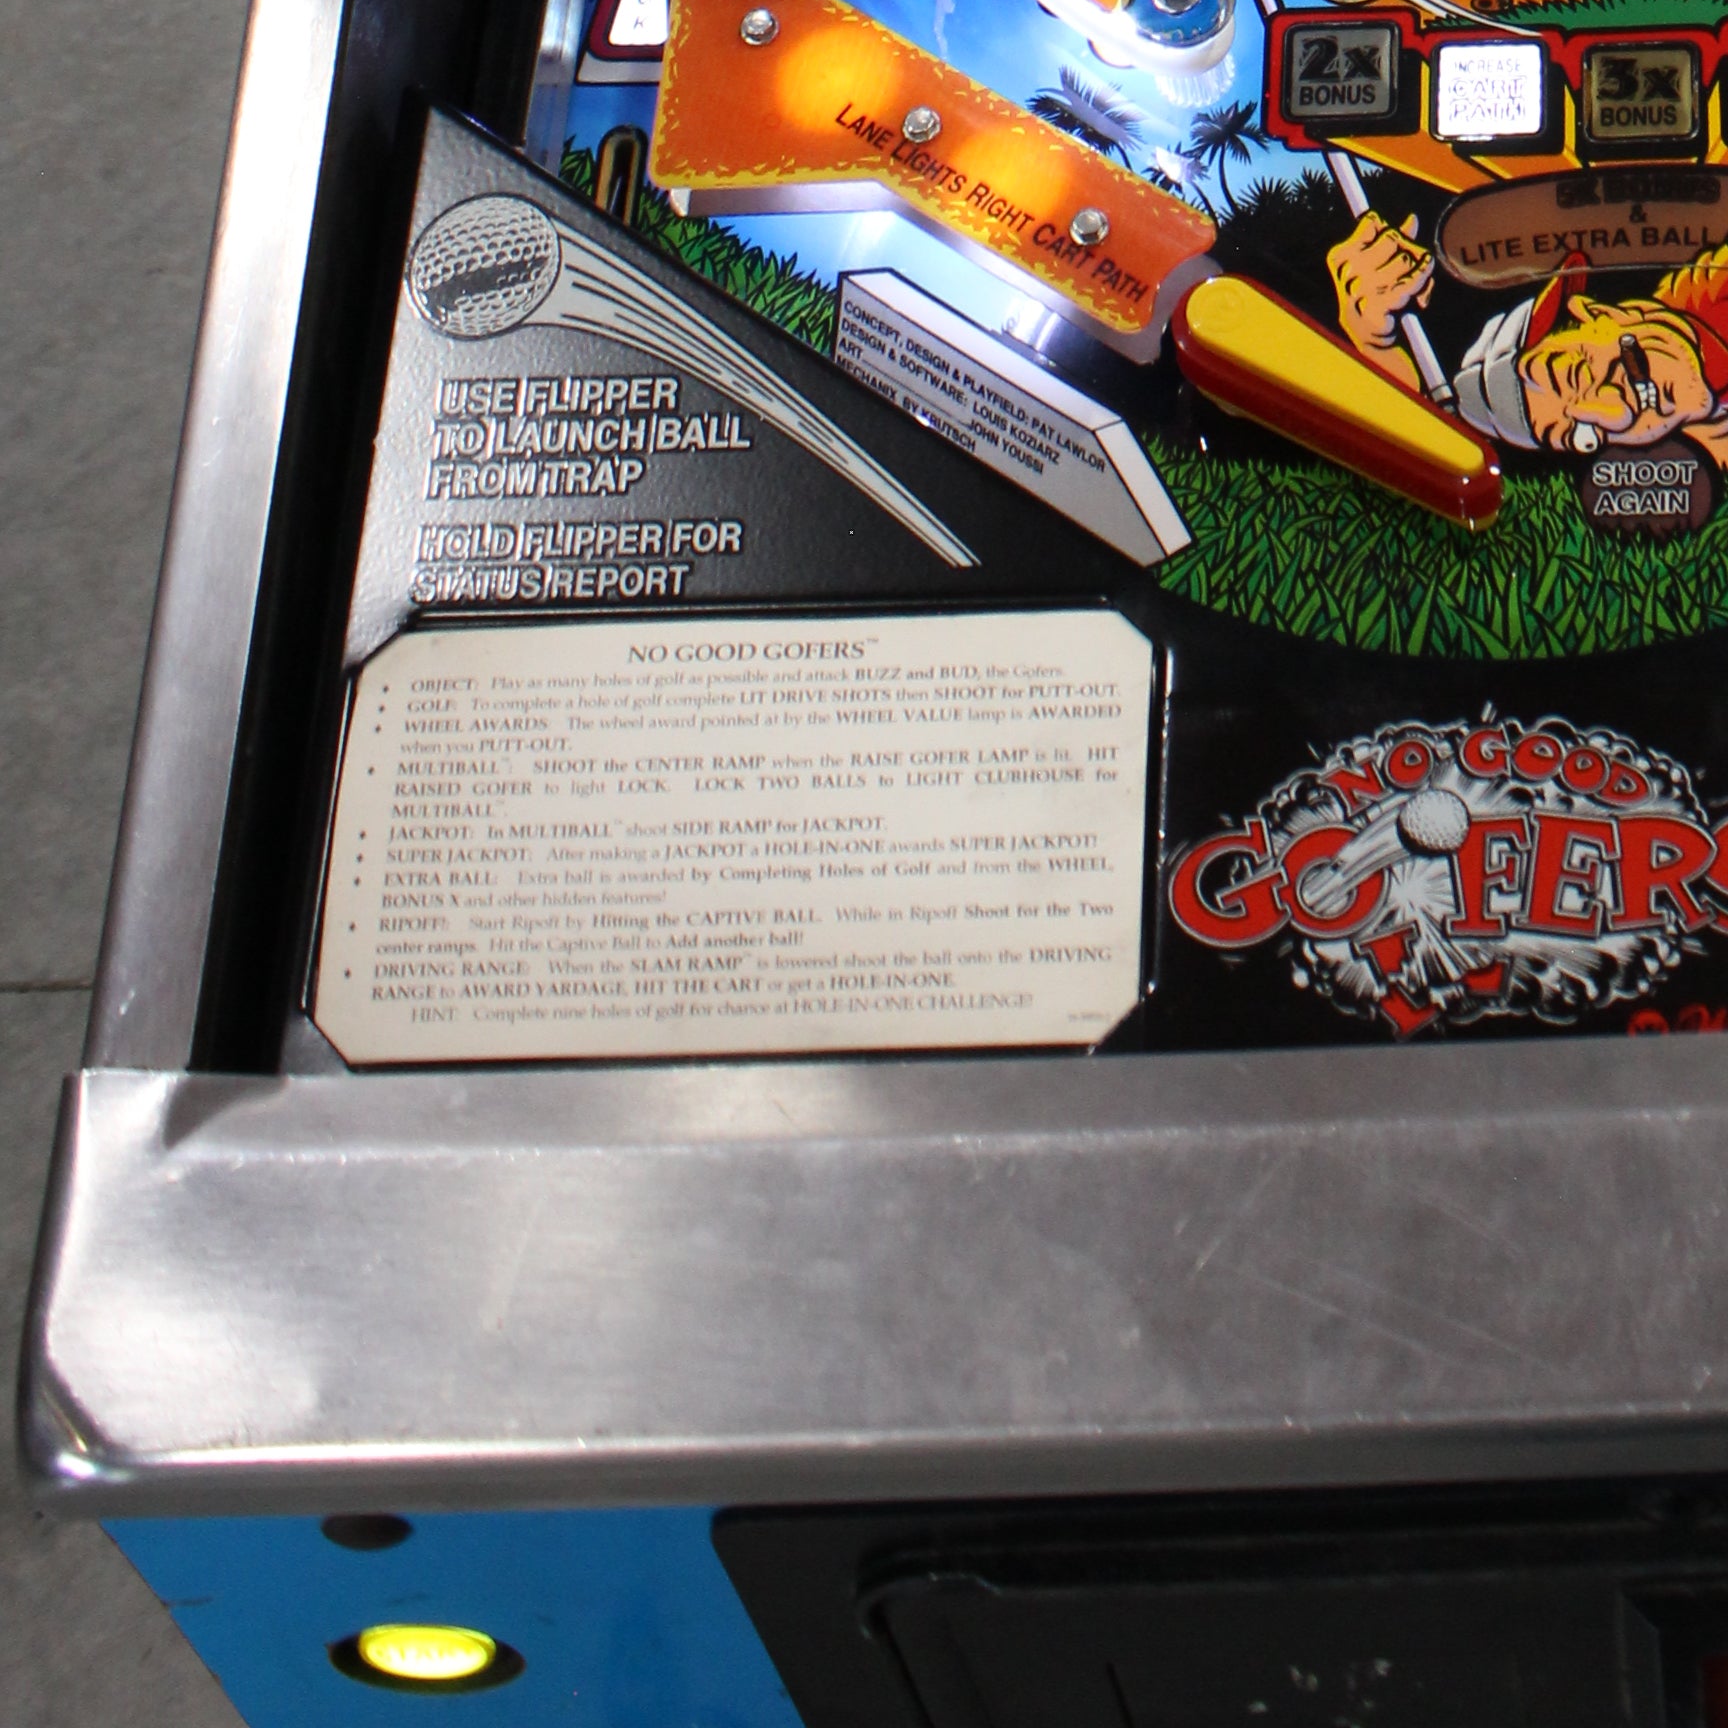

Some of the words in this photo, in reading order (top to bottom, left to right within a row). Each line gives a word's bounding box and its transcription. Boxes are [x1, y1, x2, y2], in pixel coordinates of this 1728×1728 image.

[1452, 57, 1523, 75] INCREASE
[1298, 82, 1377, 107] BONUS
[1600, 105, 1678, 127] BONUS
[834, 102, 889, 153] LANE
[889, 134, 967, 196] LIGHTS
[965, 180, 1035, 236] RIGHT
[1032, 220, 1096, 277] CART
[1091, 253, 1149, 305] PATH
[1459, 240, 1526, 267] LITE
[1532, 229, 1632, 257] EXTRA
[1640, 224, 1716, 250] BALL
[441, 379, 517, 415] USE
[524, 376, 680, 415] FLIPPER
[906, 336, 951, 374] DESIGN
[1057, 432, 1107, 473] LAWLOR
[436, 422, 485, 454] TO
[494, 418, 649, 454] LAUNCH
[655, 414, 751, 450] BALL
[972, 399, 1008, 430] LOUIS
[1009, 424, 1061, 465] KOZIARZ
[428, 460, 544, 498] FROM
[545, 458, 645, 497] TRAP
[1591, 460, 1698, 487] SHOOT
[1594, 488, 1690, 515] AGAIN
[419, 523, 518, 561] HOLD
[521, 521, 665, 559] FLIPPER
[669, 520, 743, 555] FOR
[411, 566, 545, 602] STATUS
[546, 563, 690, 600] REPORT
[627, 644, 668, 663] NO
[674, 643, 756, 662] GOOD
[835, 708, 898, 724] WHEEL
[1027, 704, 1122, 720] AWARDED
[635, 755, 703, 773] CENTER
[974, 768, 1085, 786] CLUBHOUSE
[1320, 739, 1434, 815] NO
[1461, 727, 1652, 806] GOOD
[1028, 947, 1112, 964] DRIVING
